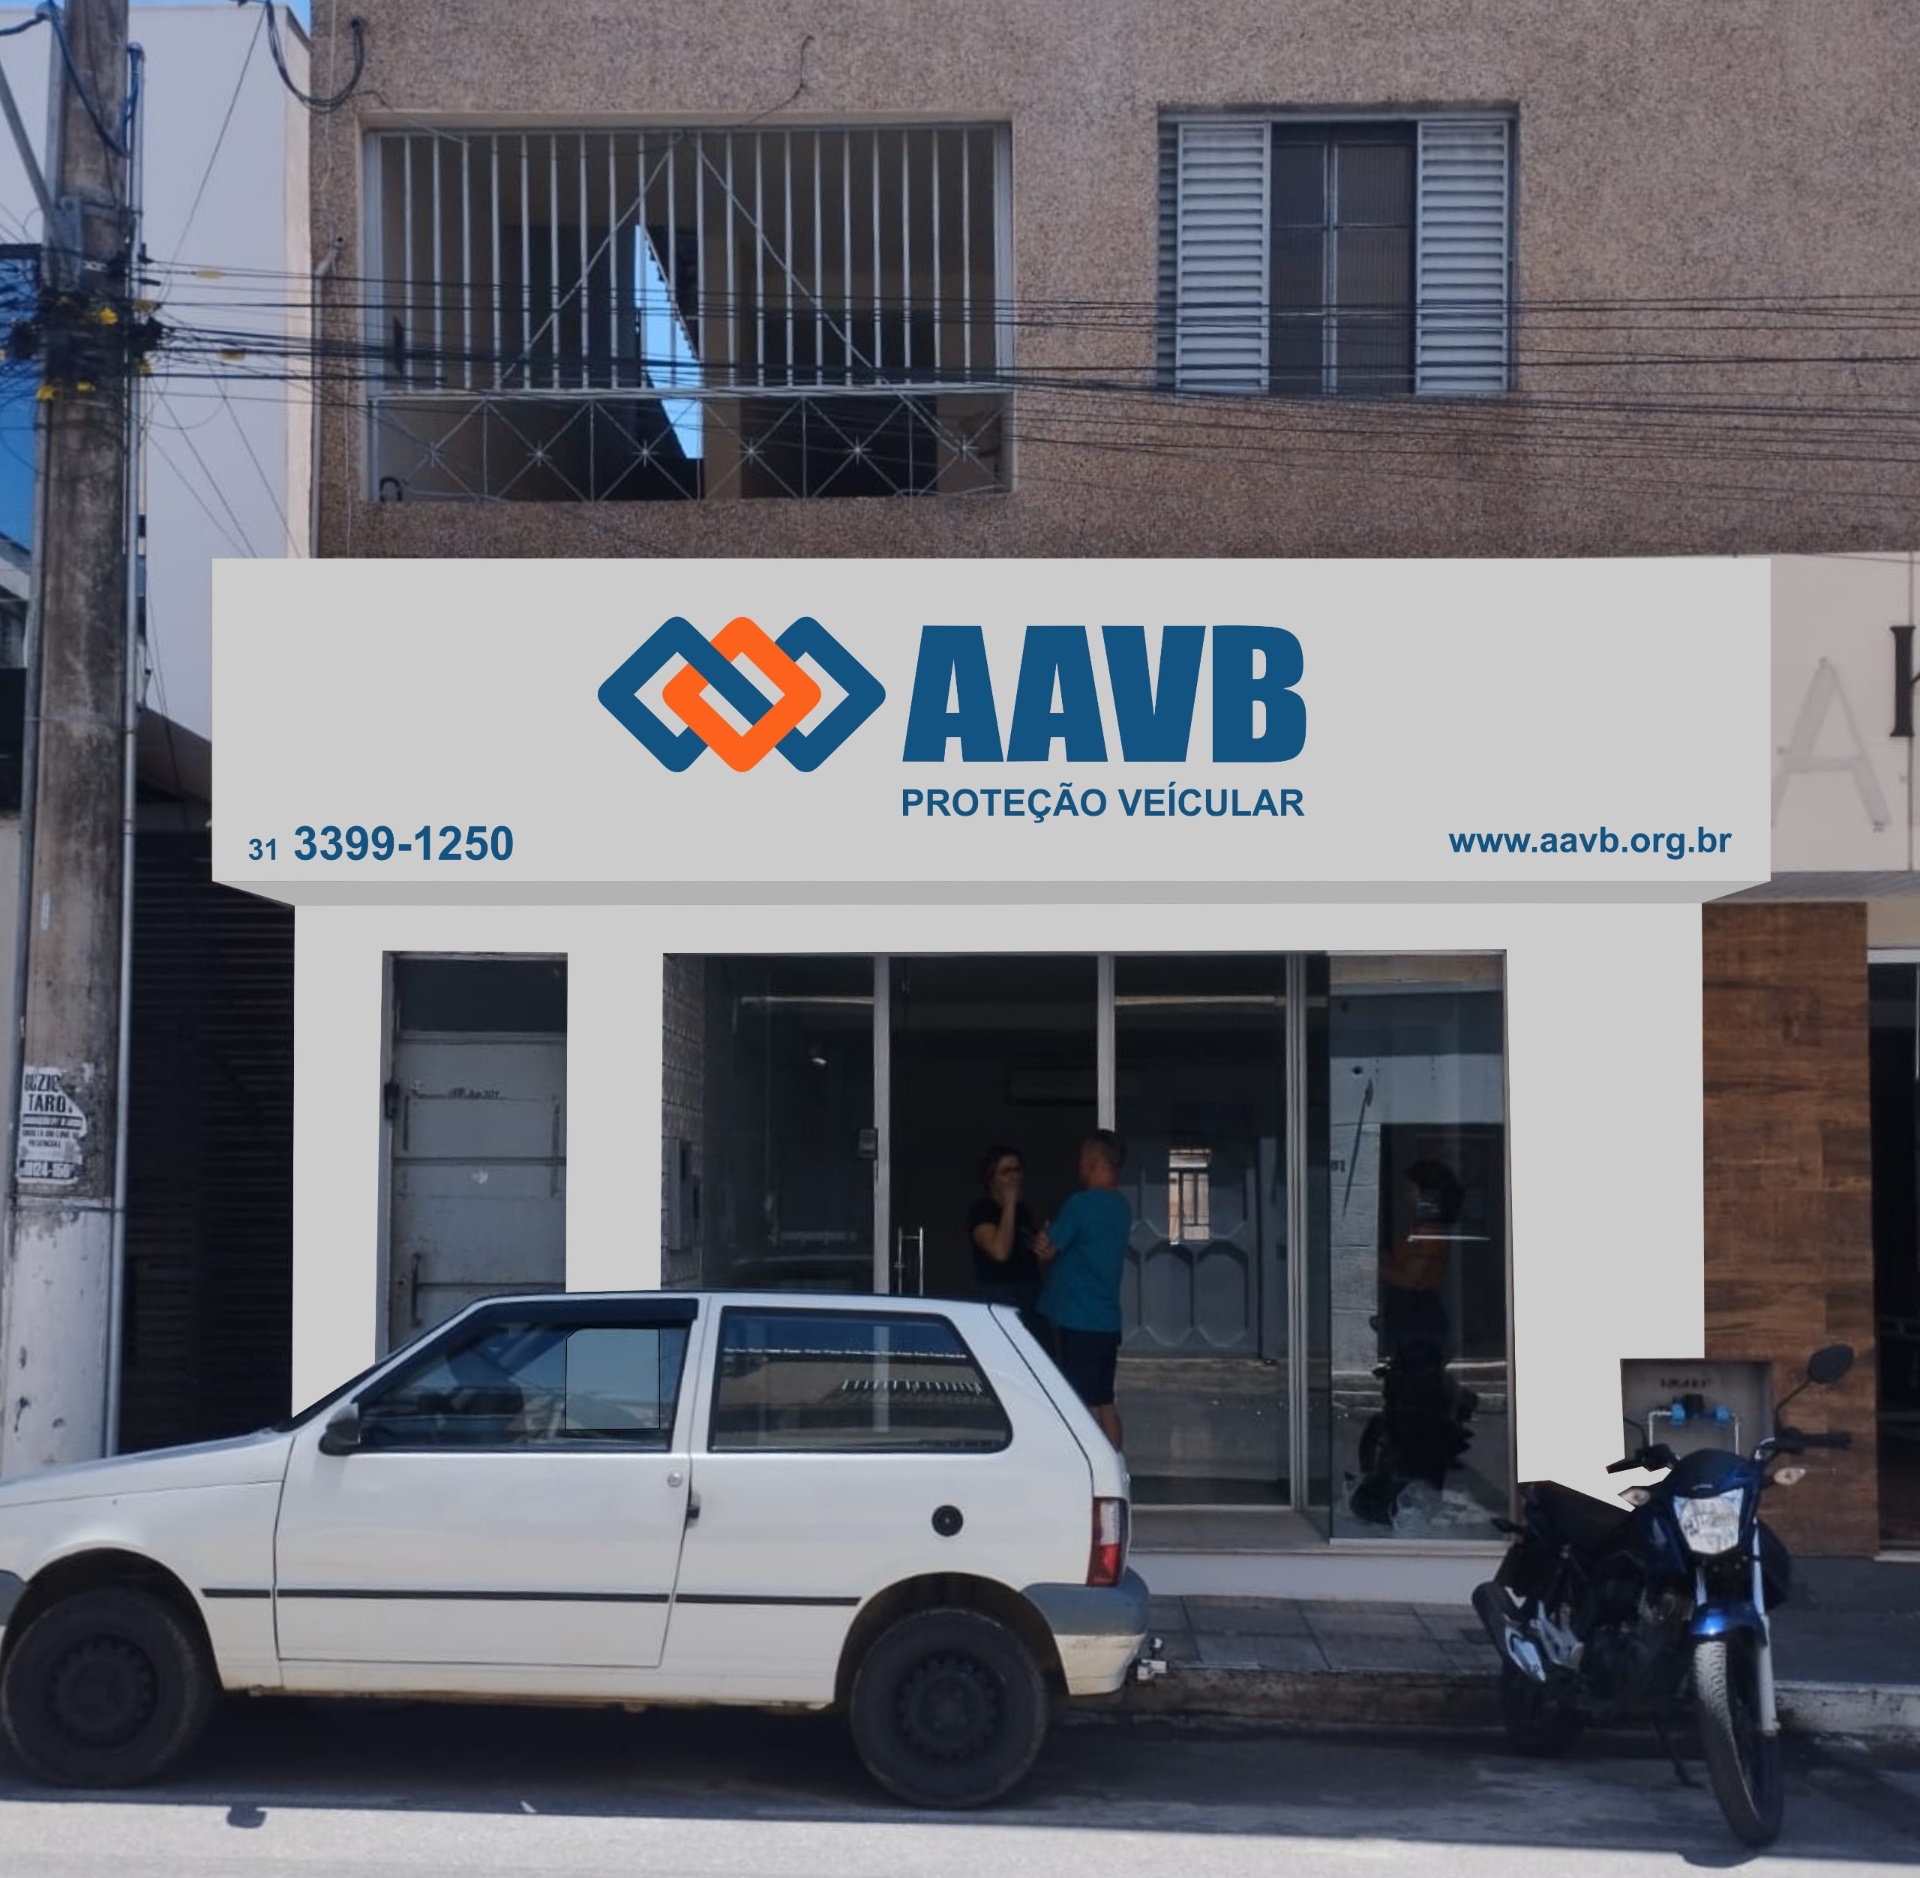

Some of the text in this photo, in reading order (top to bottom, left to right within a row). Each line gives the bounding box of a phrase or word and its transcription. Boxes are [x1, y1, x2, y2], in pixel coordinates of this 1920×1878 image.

[902, 624, 1308, 763] AAVB
[902, 781, 1306, 824] PROTEÇÃO VEÍCULAR
[248, 825, 514, 863] 31 3399-1250
[1448, 825, 1733, 861] www.aavb.org.br
